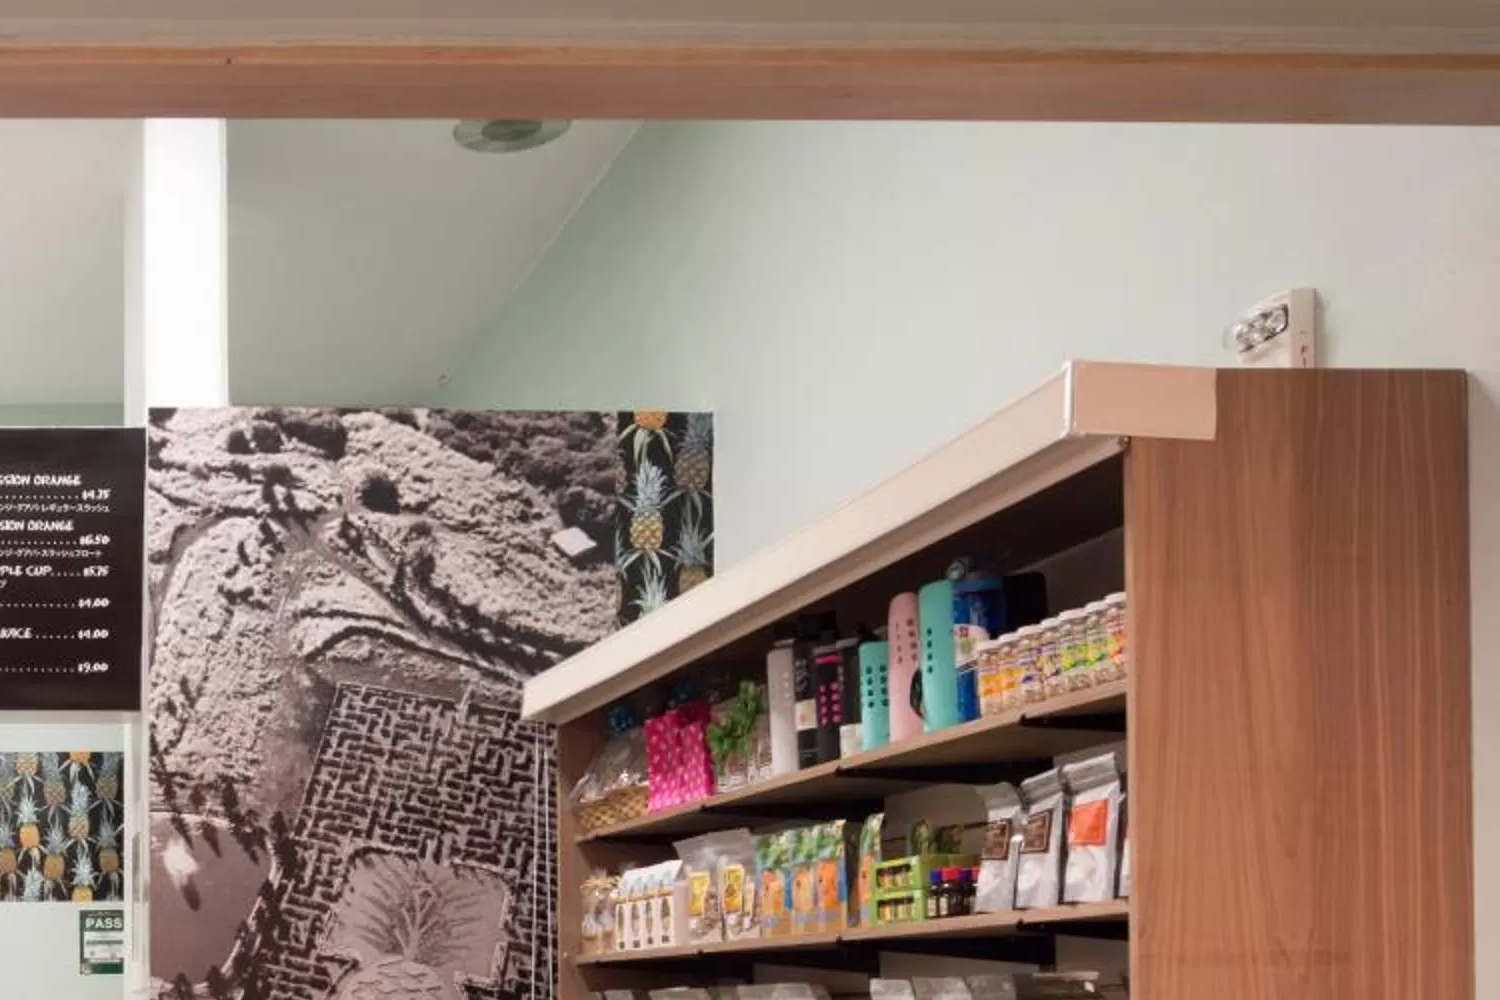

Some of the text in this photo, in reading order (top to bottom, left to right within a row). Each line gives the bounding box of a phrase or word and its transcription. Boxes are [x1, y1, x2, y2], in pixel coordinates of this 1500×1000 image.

[33, 473, 82, 485] ORANGE
[27, 519, 74, 531] ORANGE
[25, 565, 53, 577] CUP
[85, 917, 124, 929] PASS
